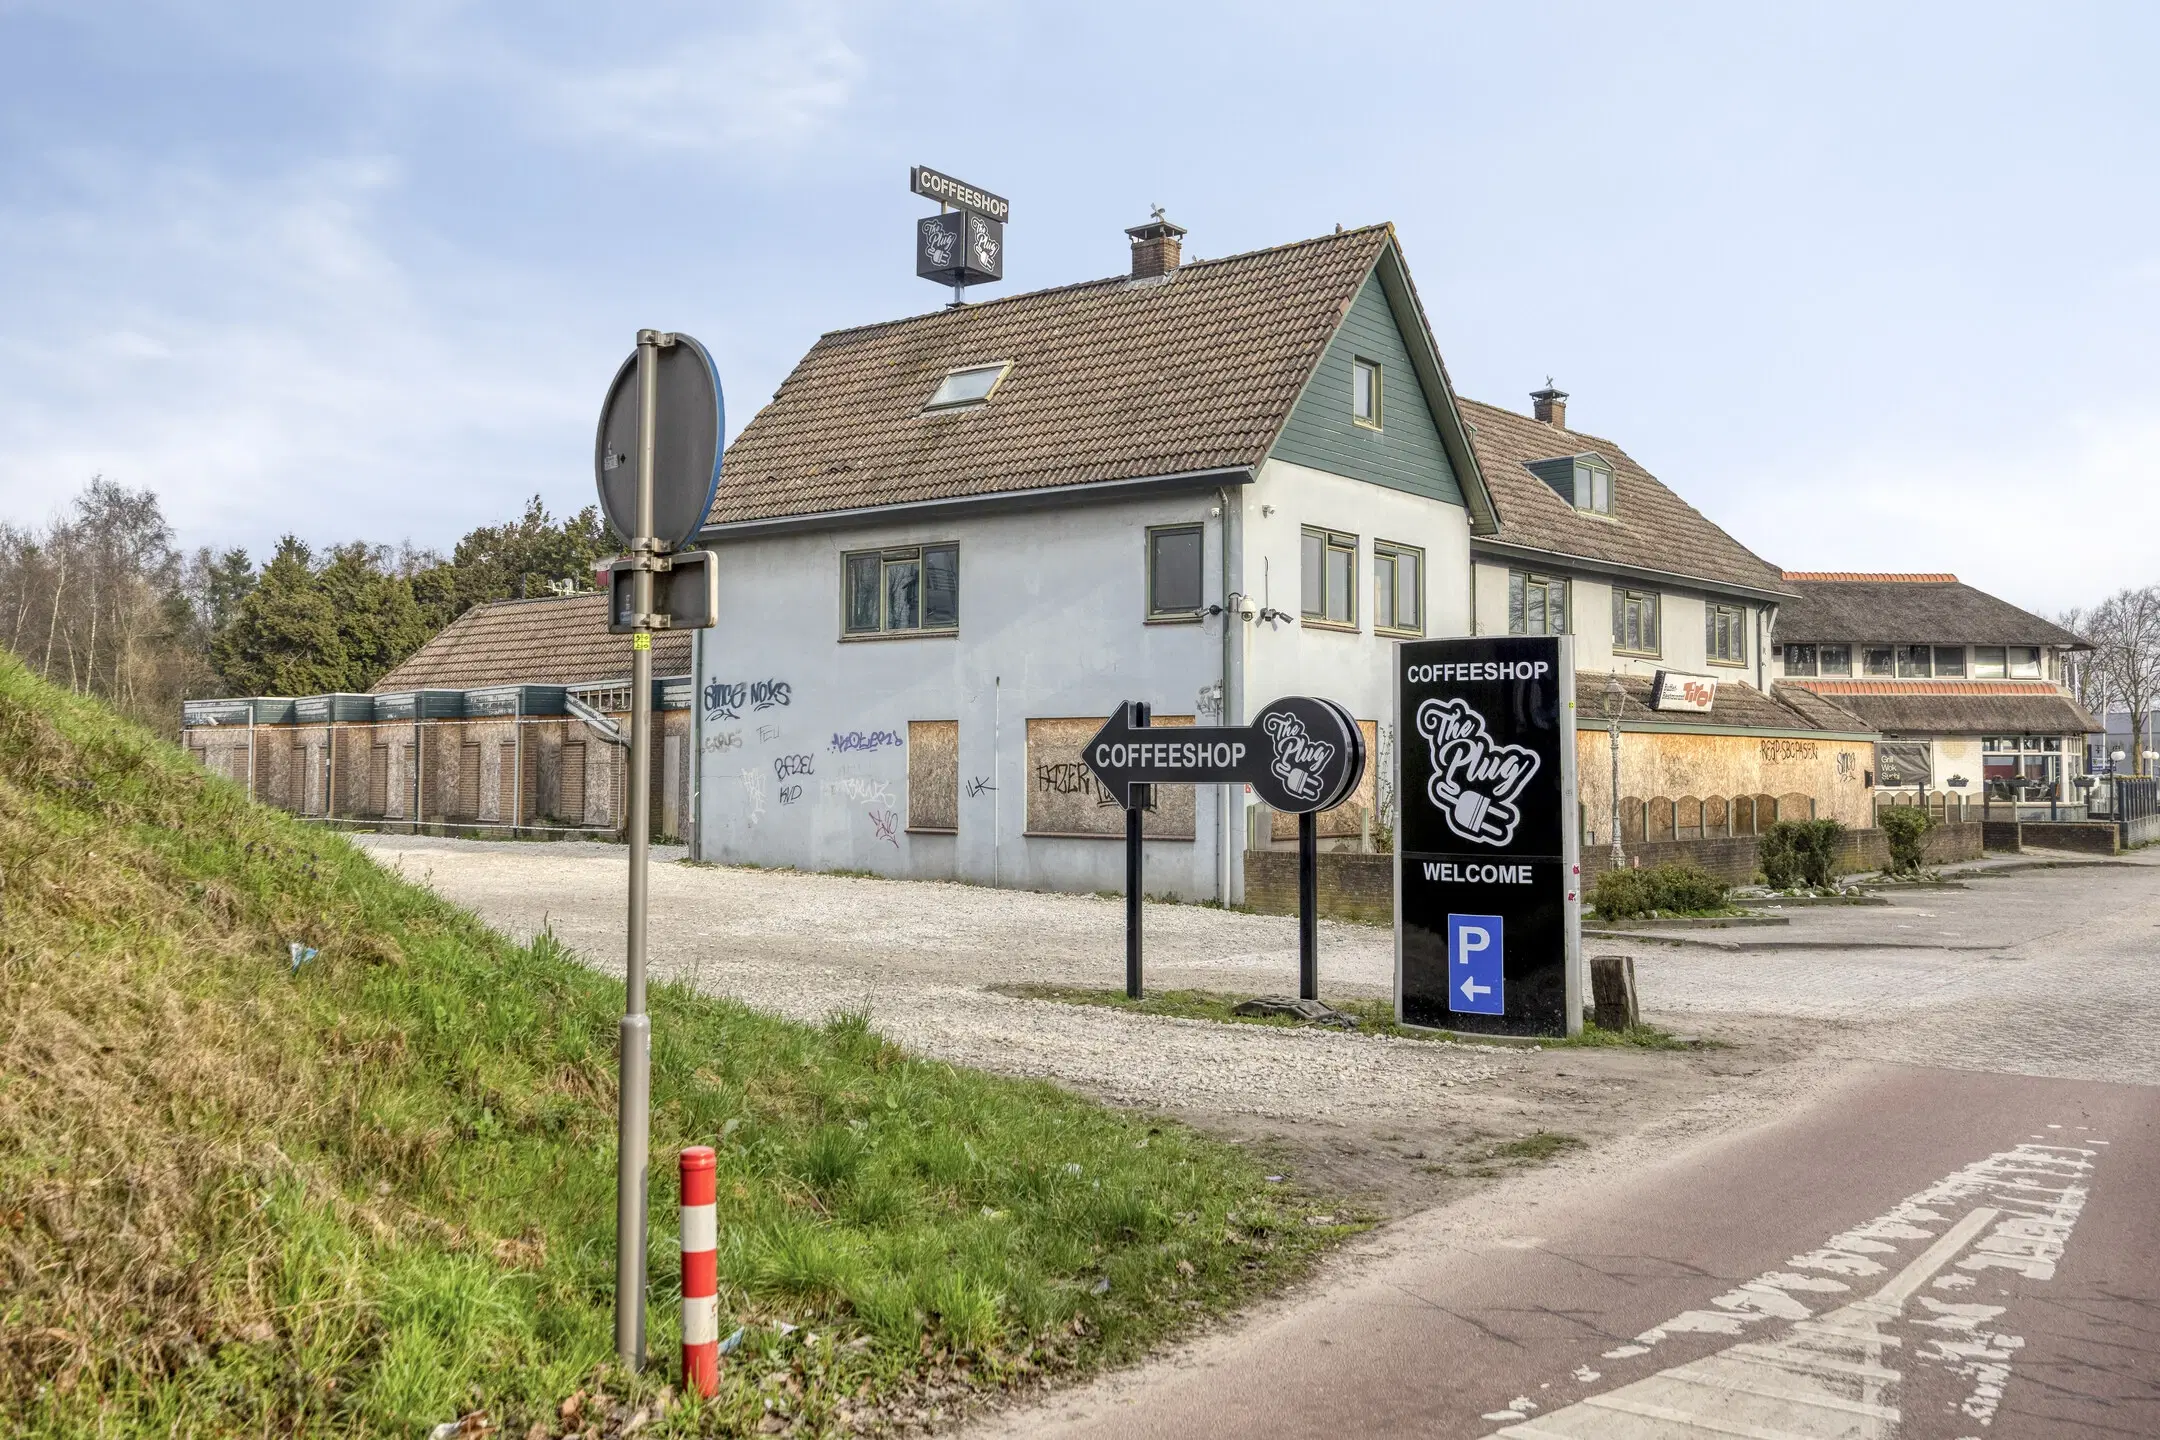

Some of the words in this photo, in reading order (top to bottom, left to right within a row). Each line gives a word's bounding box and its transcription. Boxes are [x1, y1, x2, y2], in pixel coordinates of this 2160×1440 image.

[921, 171, 1008, 217] COFFEESHOP
[924, 222, 940, 235] The
[972, 219, 986, 234] The
[929, 231, 955, 250] Plug
[977, 232, 998, 255] Plug
[1407, 661, 1549, 683] COFFEESHOP
[1683, 682, 1715, 707] Tirol
[1268, 717, 1300, 740] The
[1425, 708, 1475, 746] The
[1095, 743, 1247, 768] COFFEESHOP
[1278, 736, 1330, 772] Plug
[1439, 738, 1529, 796] Plug
[1423, 862, 1533, 884] WELCOME
[1459, 926, 1491, 964] P
